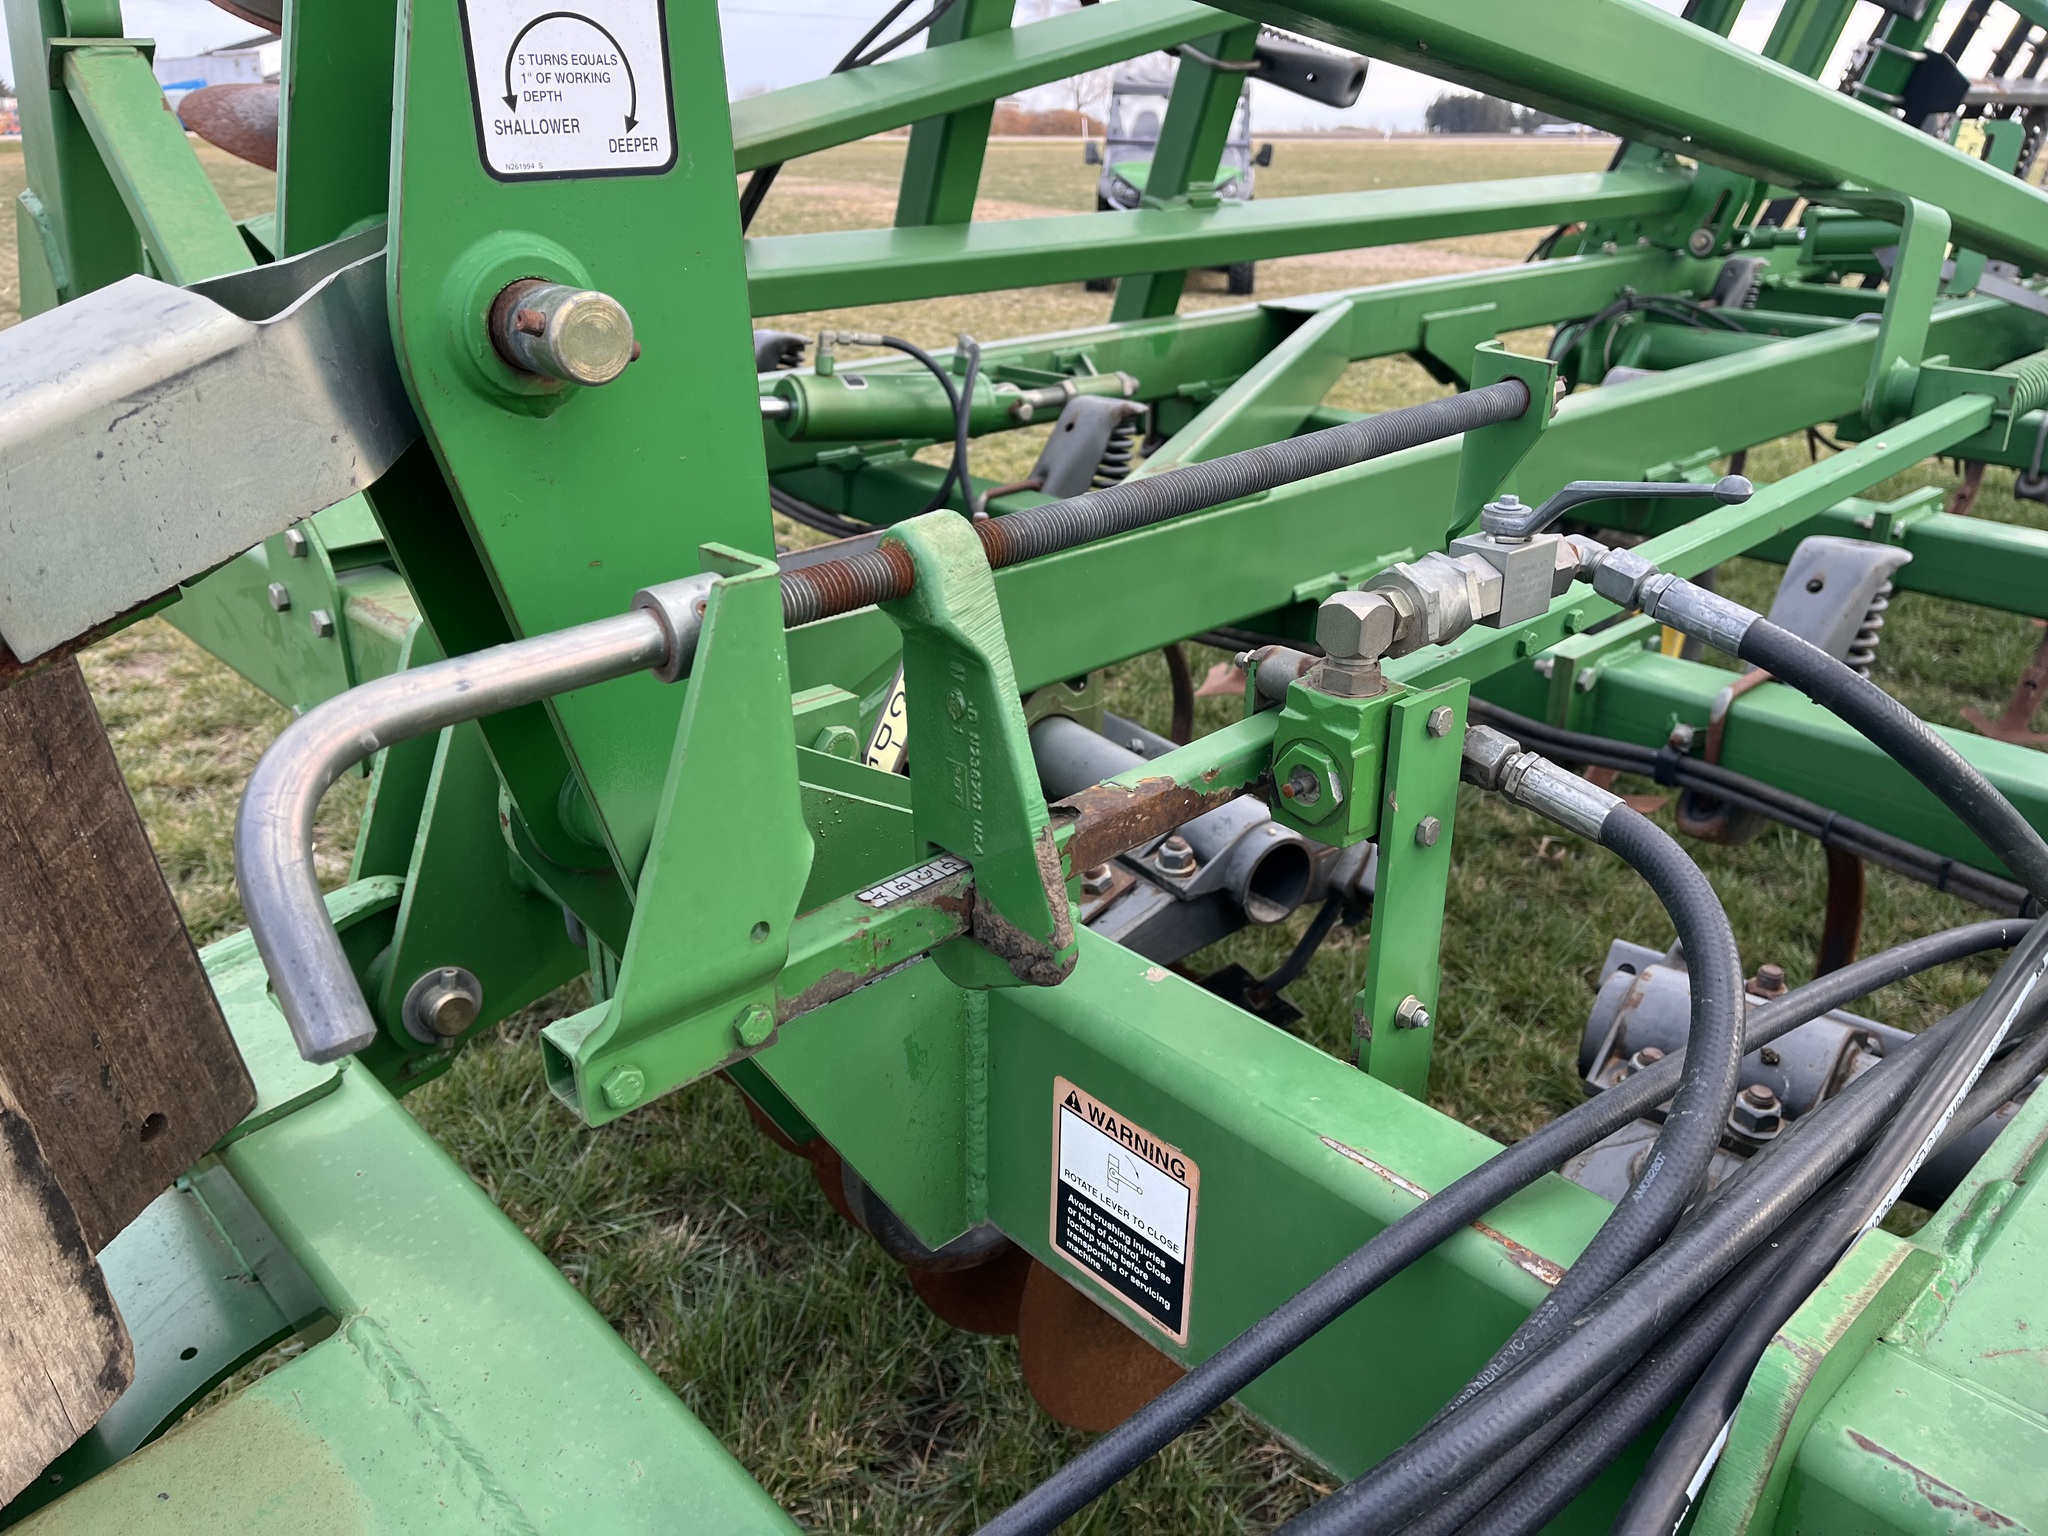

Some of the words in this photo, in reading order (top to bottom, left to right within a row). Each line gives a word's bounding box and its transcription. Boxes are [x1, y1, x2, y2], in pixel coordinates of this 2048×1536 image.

[518, 54, 525, 66] 5
[527, 54, 568, 66] TURNS
[571, 54, 618, 66] EQUALS
[520, 72, 532, 84] 1"
[536, 72, 552, 84] OF
[554, 72, 611, 84] WORKING
[523, 90, 563, 102] DEPTH
[494, 118, 580, 135] SHALLOWER
[608, 137, 659, 153] DEEPER
[1088, 1102, 1186, 1181] WARNING
[1064, 1168, 1098, 1198] ROTATE
[1100, 1193, 1130, 1220] LEVER
[1132, 1215, 1145, 1230] TO
[1147, 1226, 1180, 1254] CLOSE
[1068, 1194, 1092, 1216] Avoid
[1093, 1212, 1132, 1245] crushing
[1132, 1237, 1166, 1268] injuries
[1066, 1240, 1104, 1272] machine.
[1066, 1228, 1118, 1272] transporting
[1118, 1267, 1129, 1278] or
[1130, 1275, 1171, 1311] servicing
[1067, 1207, 1076, 1217] or
[1078, 1212, 1096, 1231] loss
[1097, 1227, 1106, 1238] of
[1108, 1234, 1142, 1264] control.
[1145, 1260, 1172, 1285] Close
[1067, 1216, 1095, 1242] lockup
[1096, 1238, 1119, 1260] valve
[1120, 1254, 1149, 1280] before
